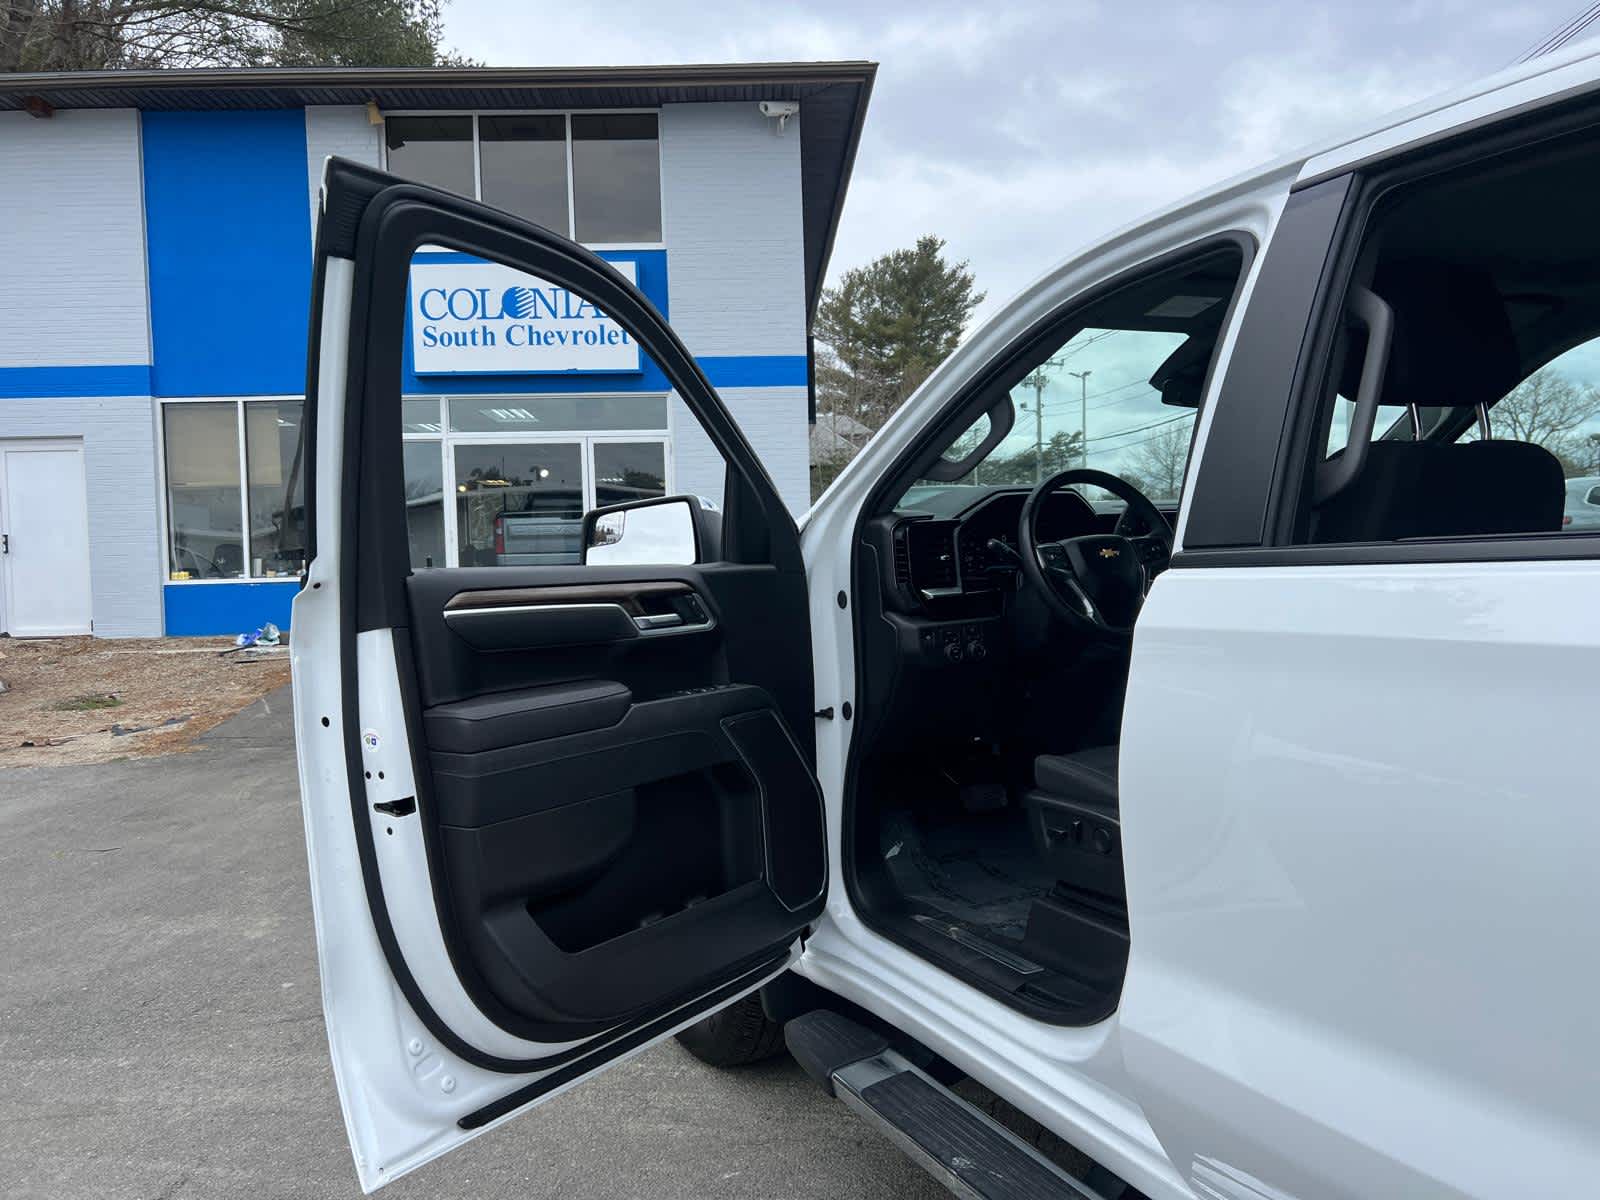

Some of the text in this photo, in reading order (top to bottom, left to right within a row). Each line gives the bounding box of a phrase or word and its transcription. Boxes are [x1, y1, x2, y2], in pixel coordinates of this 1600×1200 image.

[420, 286, 608, 321] COLONIA
[423, 324, 630, 347] South Chevrolet
